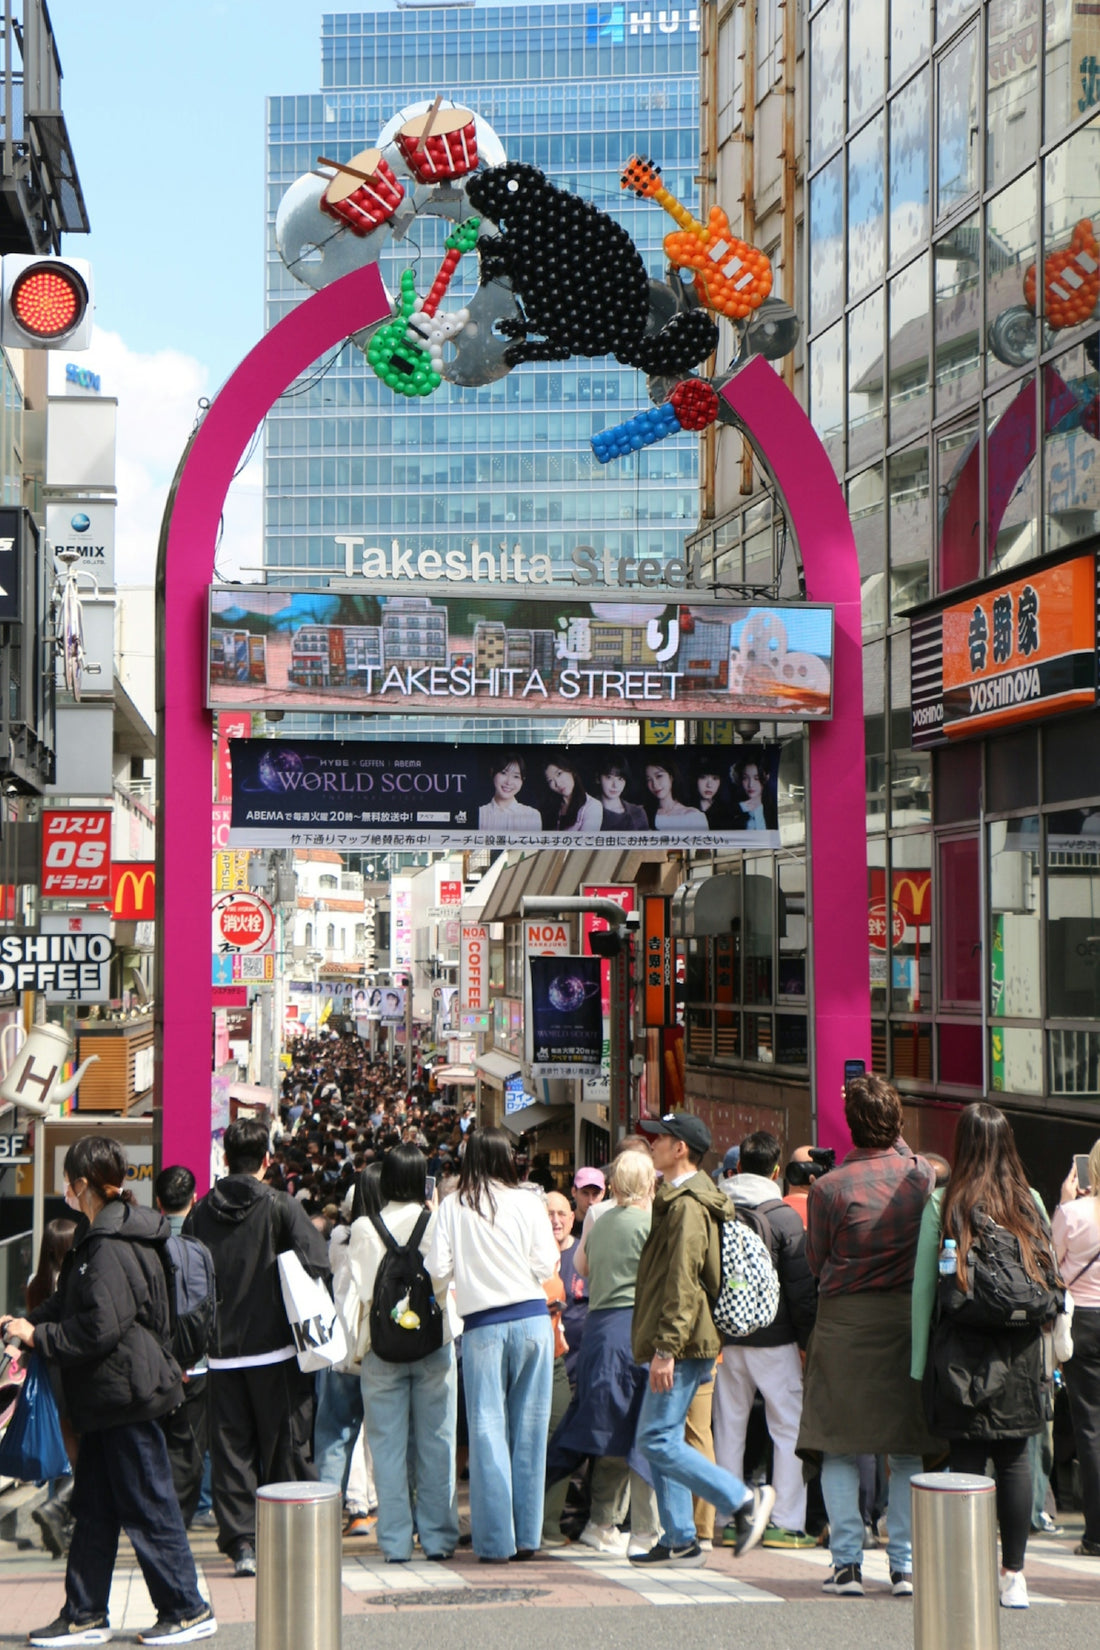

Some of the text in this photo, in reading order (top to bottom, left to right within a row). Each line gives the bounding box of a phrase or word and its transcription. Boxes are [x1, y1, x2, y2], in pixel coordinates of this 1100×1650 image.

[335, 536, 705, 590] Takeshita Street
[967, 585, 1040, 674] 吉野家
[358, 665, 685, 700] TAKESHITA STREET
[969, 668, 1041, 714] YOSHINOYA
[277, 771, 467, 793] WORLD SCOUT
[48, 817, 105, 834] クスリ
[46, 841, 107, 868] OS
[45, 875, 107, 890] ドラッグ
[223, 914, 262, 933] 消火栓
[462, 927, 487, 938] NOA
[528, 926, 567, 941] NOA
[468, 942, 481, 1008] COFFEE
[648, 936, 661, 987] 吉野家
[15, 1055, 58, 1103] H
